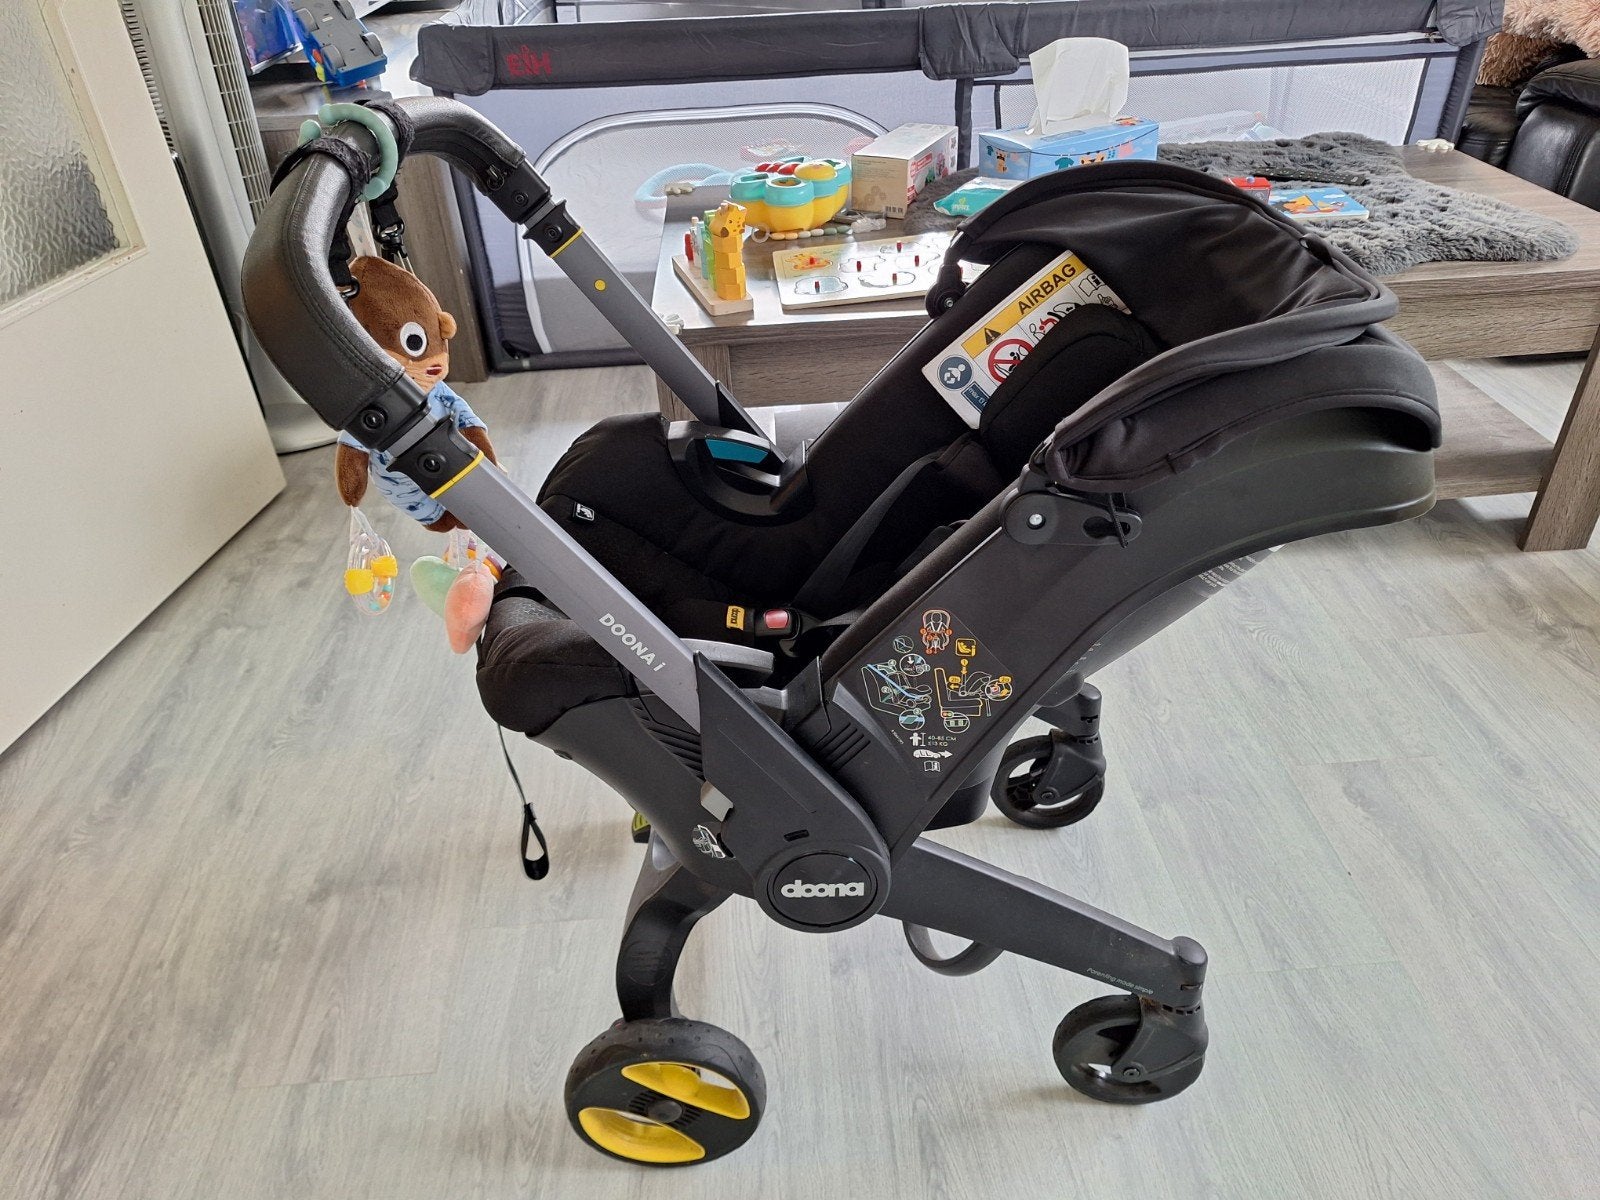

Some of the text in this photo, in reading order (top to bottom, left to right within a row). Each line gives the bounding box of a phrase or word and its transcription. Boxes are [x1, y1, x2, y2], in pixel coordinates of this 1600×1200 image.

[1018, 263, 1076, 315] AIRBAG
[599, 613, 666, 672] DOONA i
[781, 880, 864, 898] doona
[1087, 967, 1116, 982] Parenting
[1116, 979, 1134, 989] made
